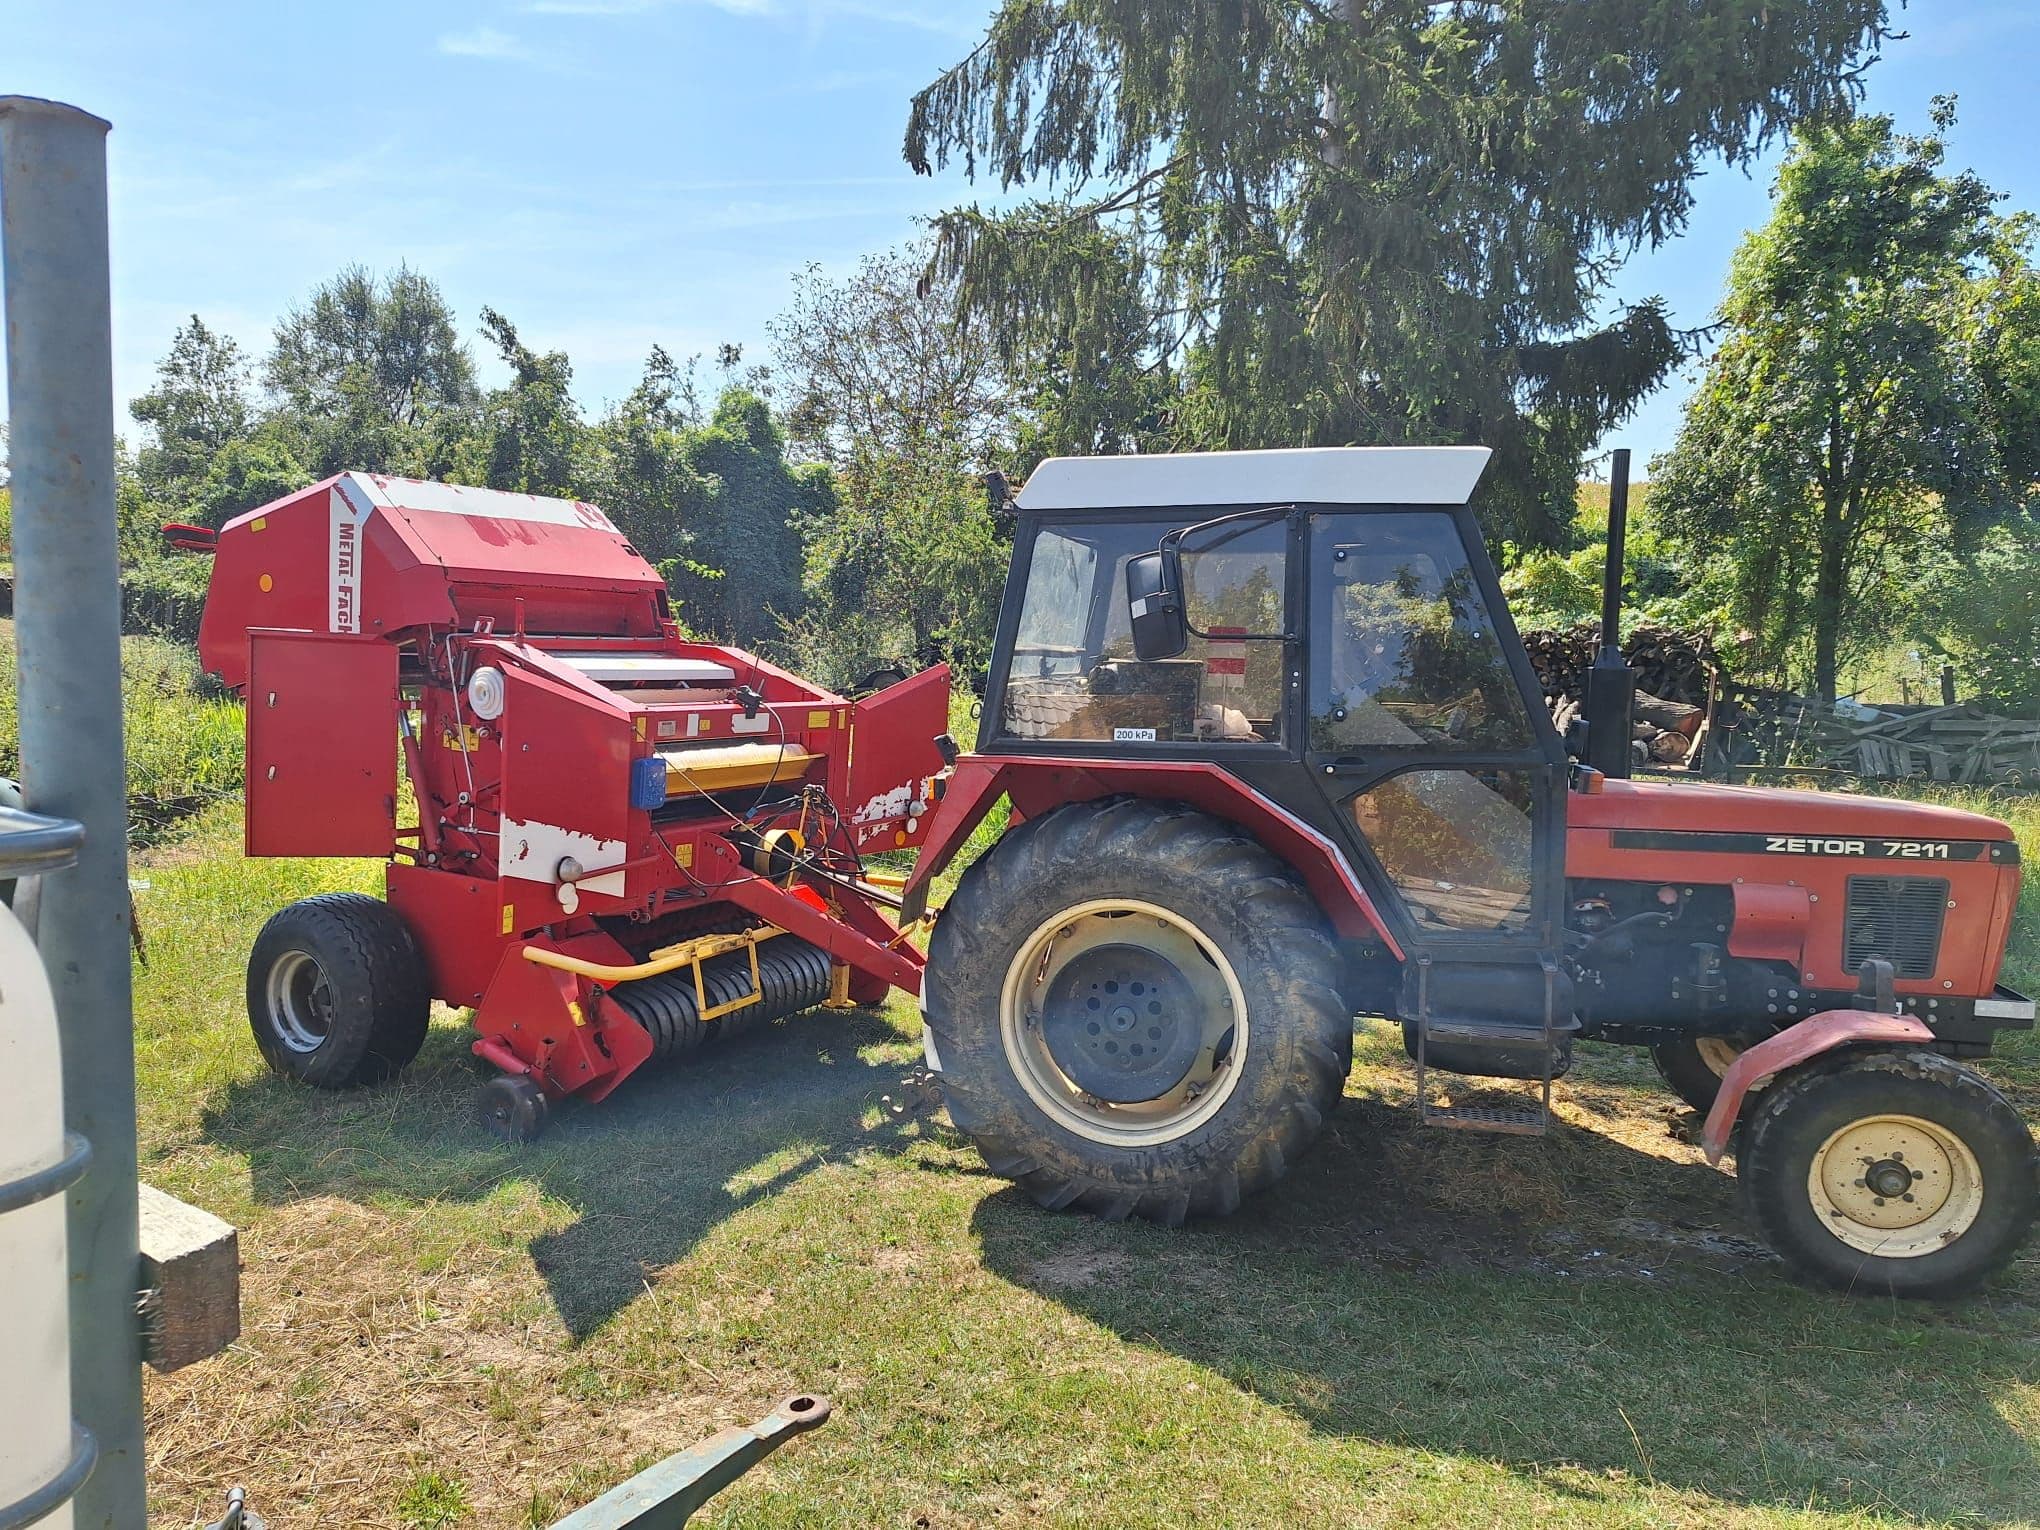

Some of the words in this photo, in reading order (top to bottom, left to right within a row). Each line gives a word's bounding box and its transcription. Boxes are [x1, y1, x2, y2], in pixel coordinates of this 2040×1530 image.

[1116, 730, 1134, 739] 200
[1135, 730, 1153, 740] kPa
[1766, 837, 1865, 855] ZETOR
[1882, 842, 1949, 859] 7211
